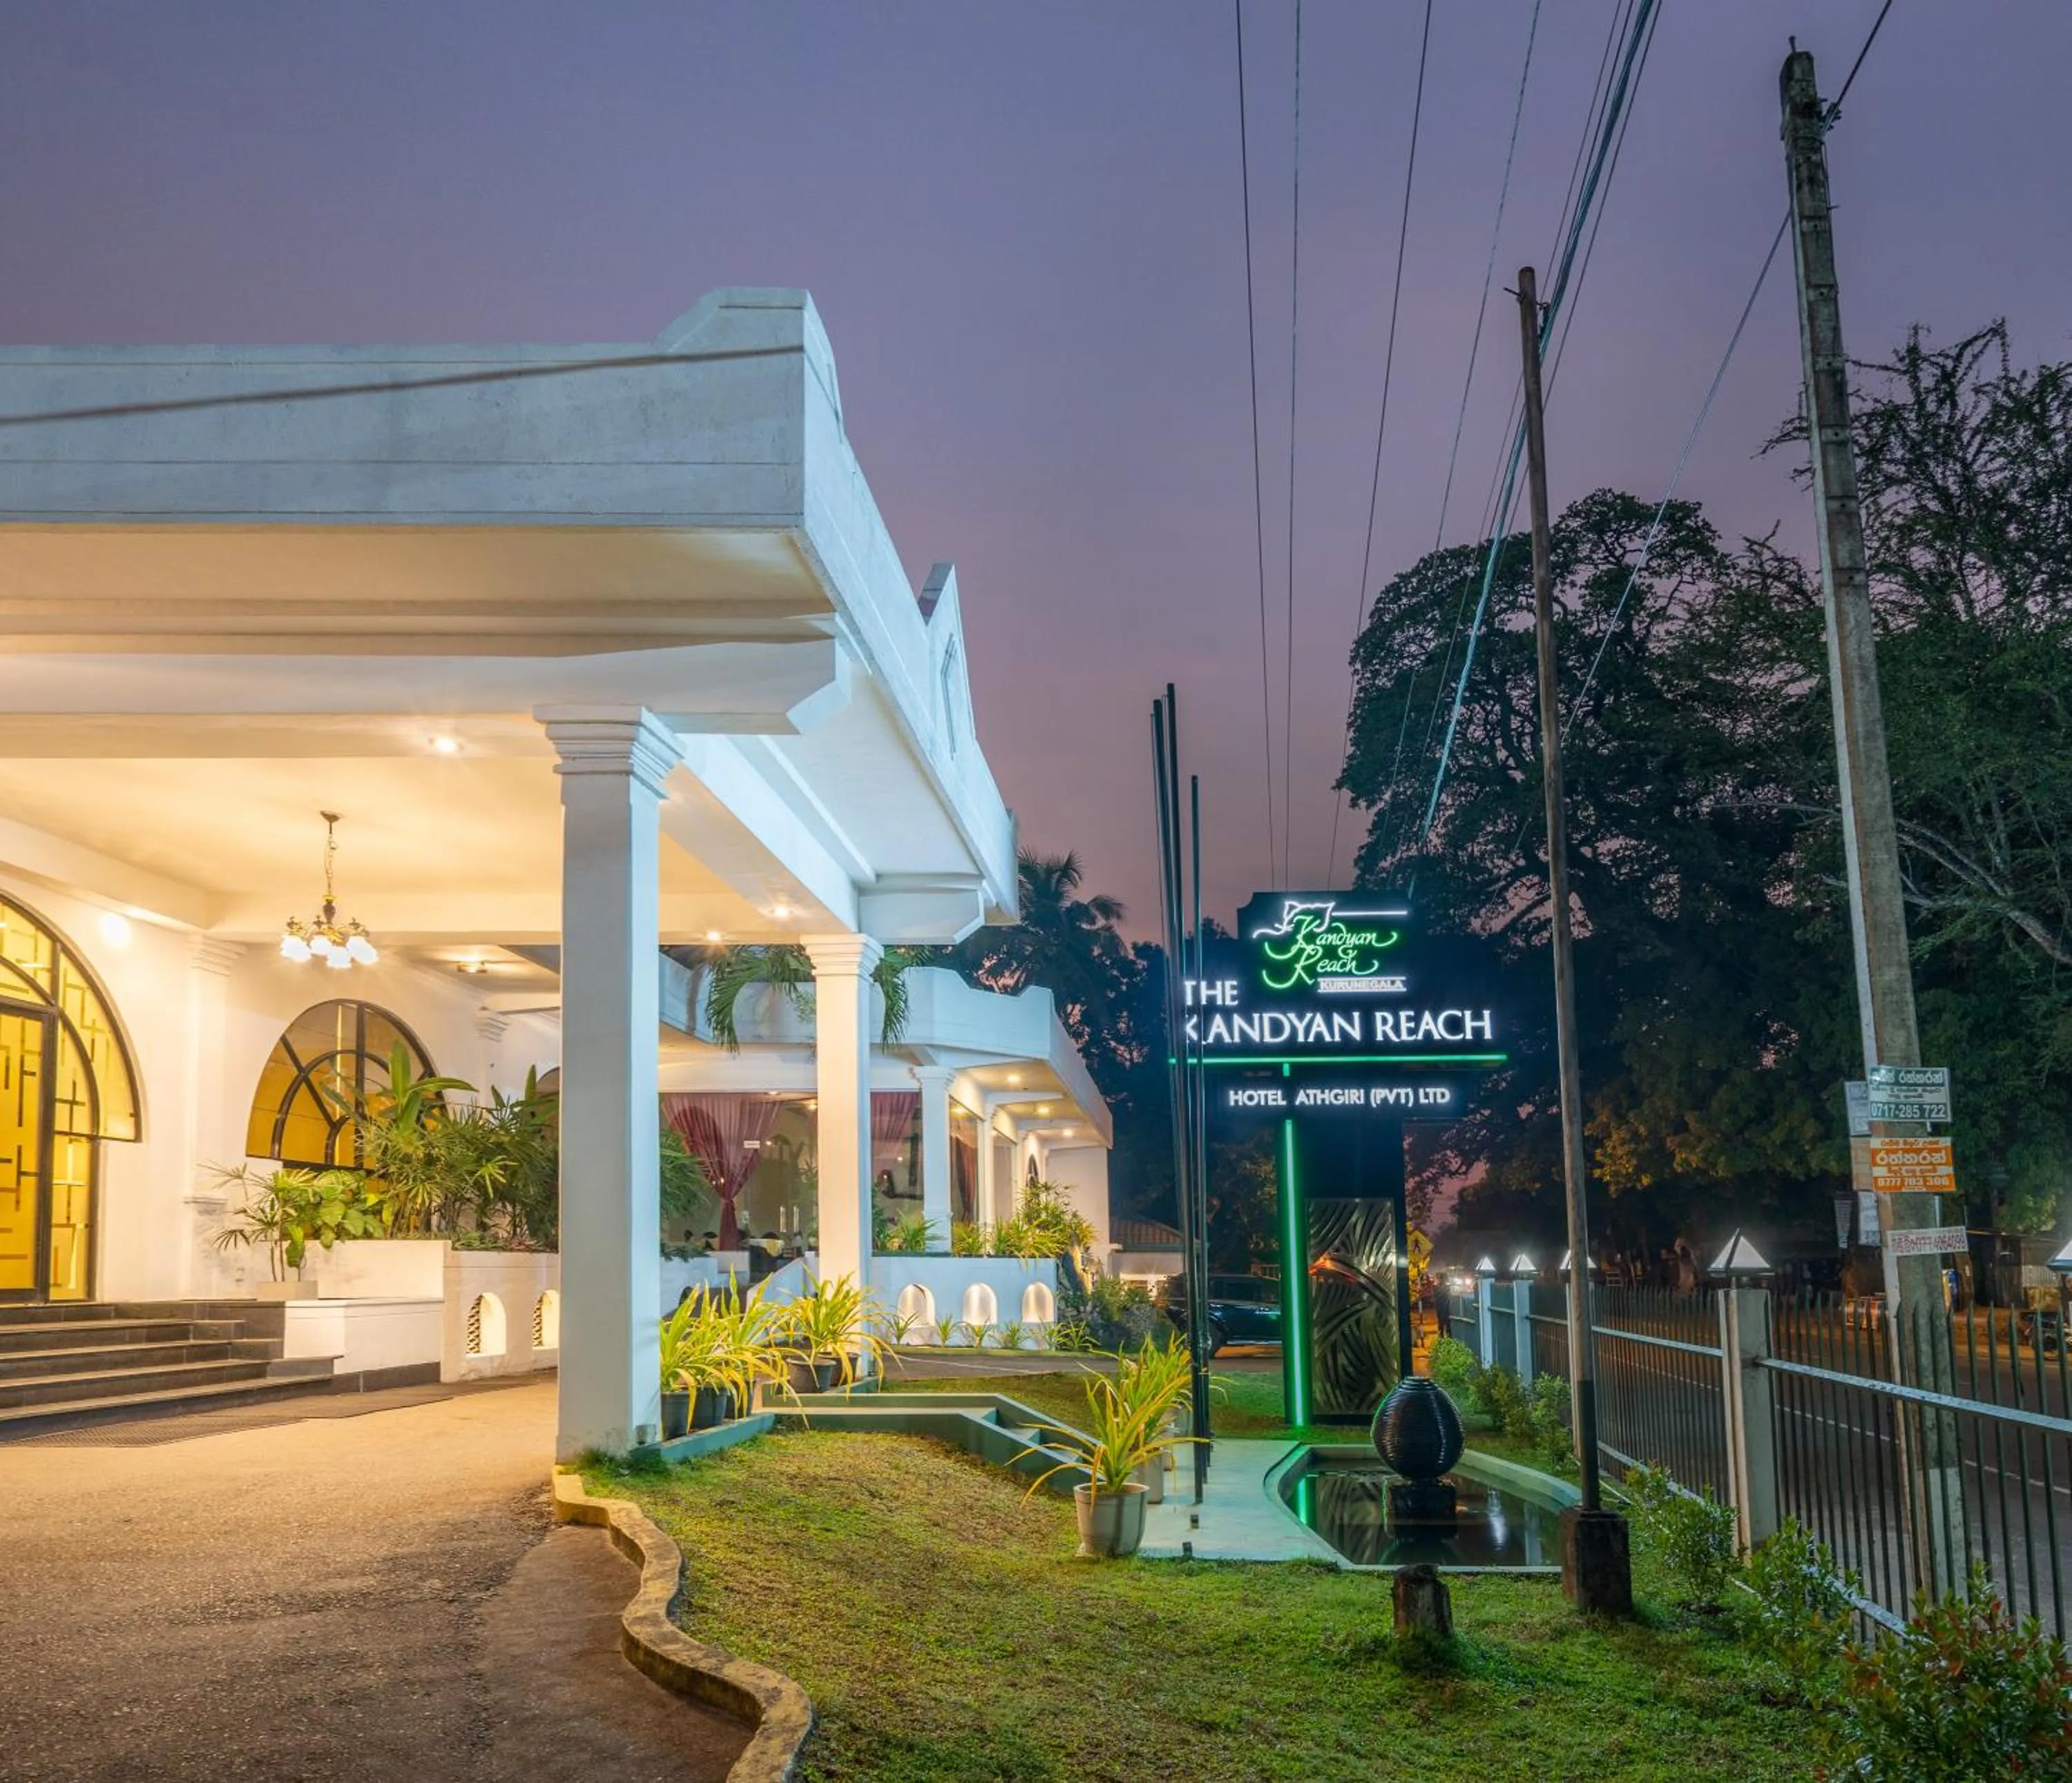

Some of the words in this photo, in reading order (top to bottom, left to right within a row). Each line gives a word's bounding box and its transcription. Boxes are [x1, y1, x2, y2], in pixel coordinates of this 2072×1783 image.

[1265, 915, 1398, 960] Kandyan
[1262, 945, 1379, 989] Reach
[1184, 981, 1238, 1005] THE
[1185, 1012, 1361, 1044] KANDYAN
[1374, 1010, 1493, 1042] REACH
[1229, 1090, 1287, 1106] HOTEL
[1296, 1089, 1365, 1105] ATHGIRI
[1370, 1088, 1414, 1107] (PVT)
[1419, 1088, 1450, 1103] LTD
[1923, 1104, 1946, 1118] 722
